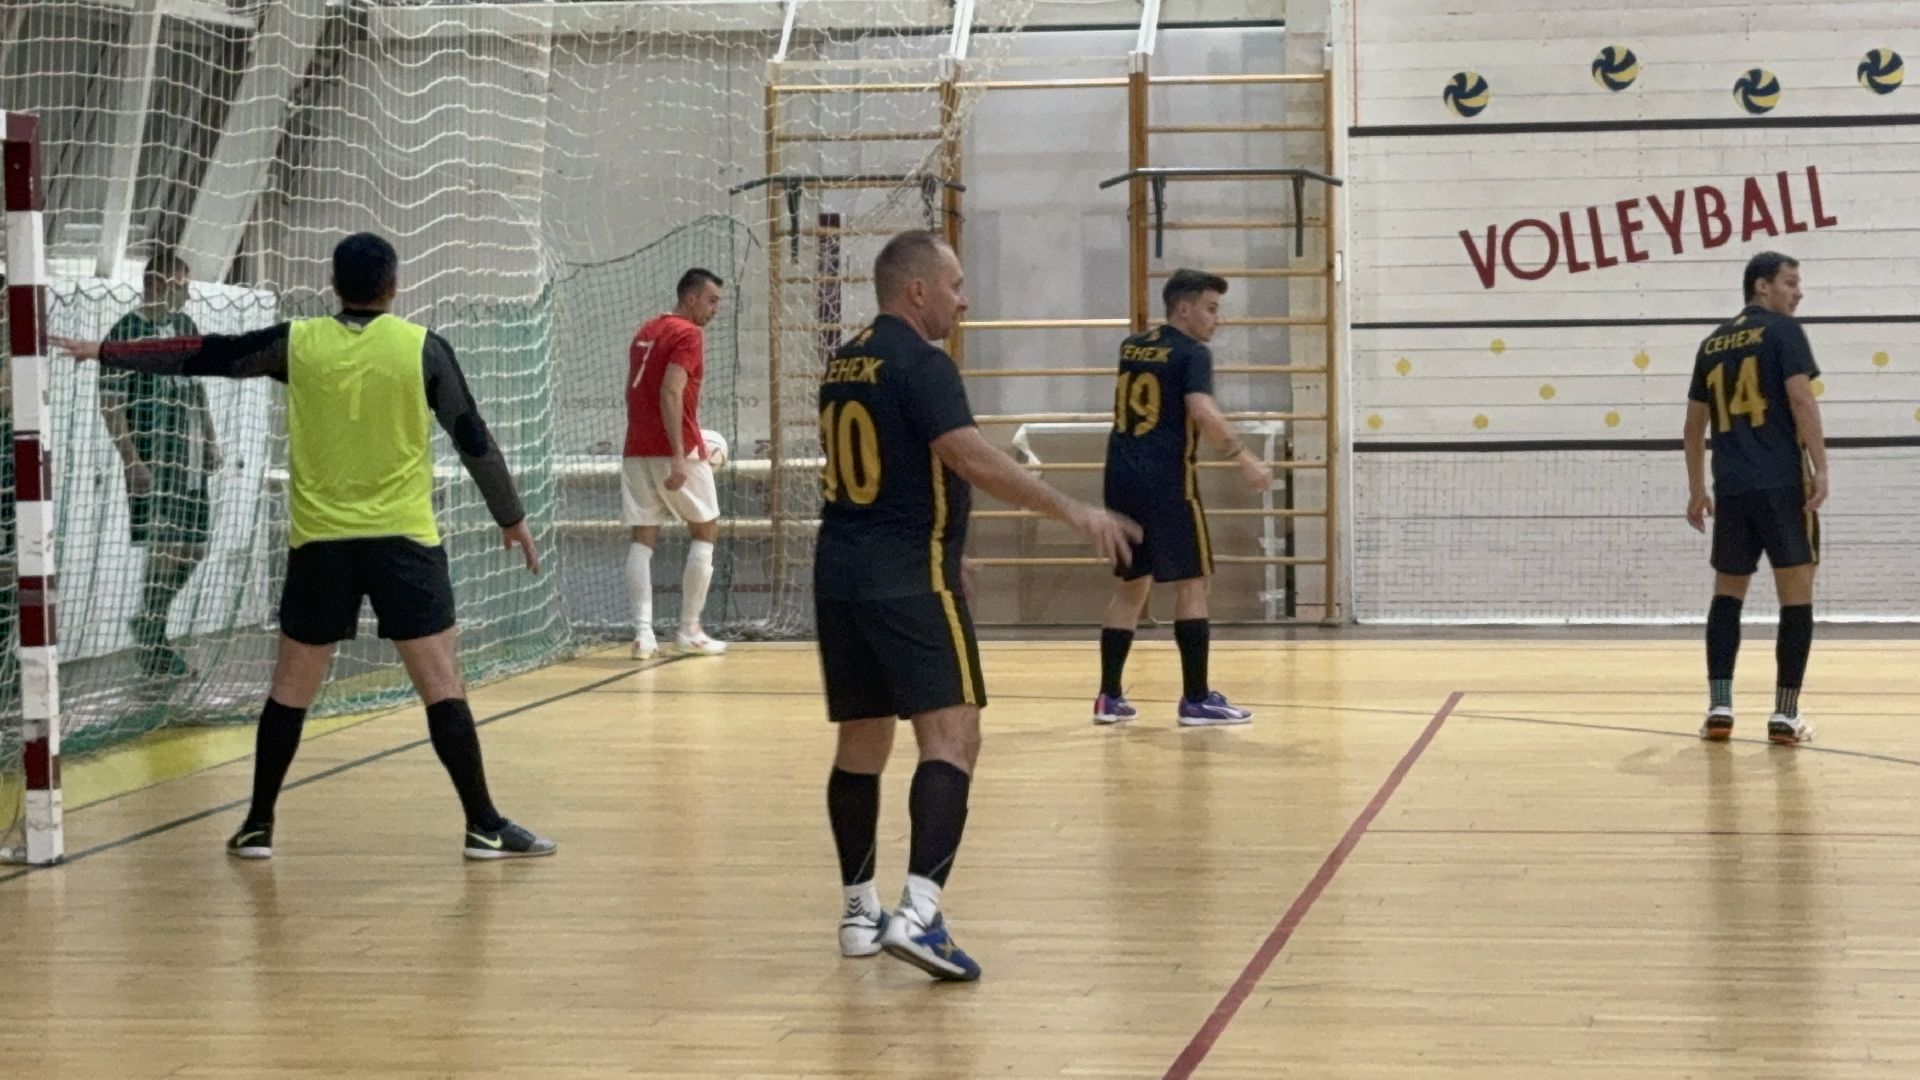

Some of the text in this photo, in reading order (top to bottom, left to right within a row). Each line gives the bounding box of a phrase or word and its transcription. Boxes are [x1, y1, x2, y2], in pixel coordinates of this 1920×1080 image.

[1458, 165, 1838, 289] VOLLEYBALL
[632, 340, 655, 388] 7
[821, 357, 884, 384] ЕНЕЖ
[1706, 355, 1768, 432] 14
[1115, 371, 1161, 436] 19
[820, 400, 881, 504] 10
